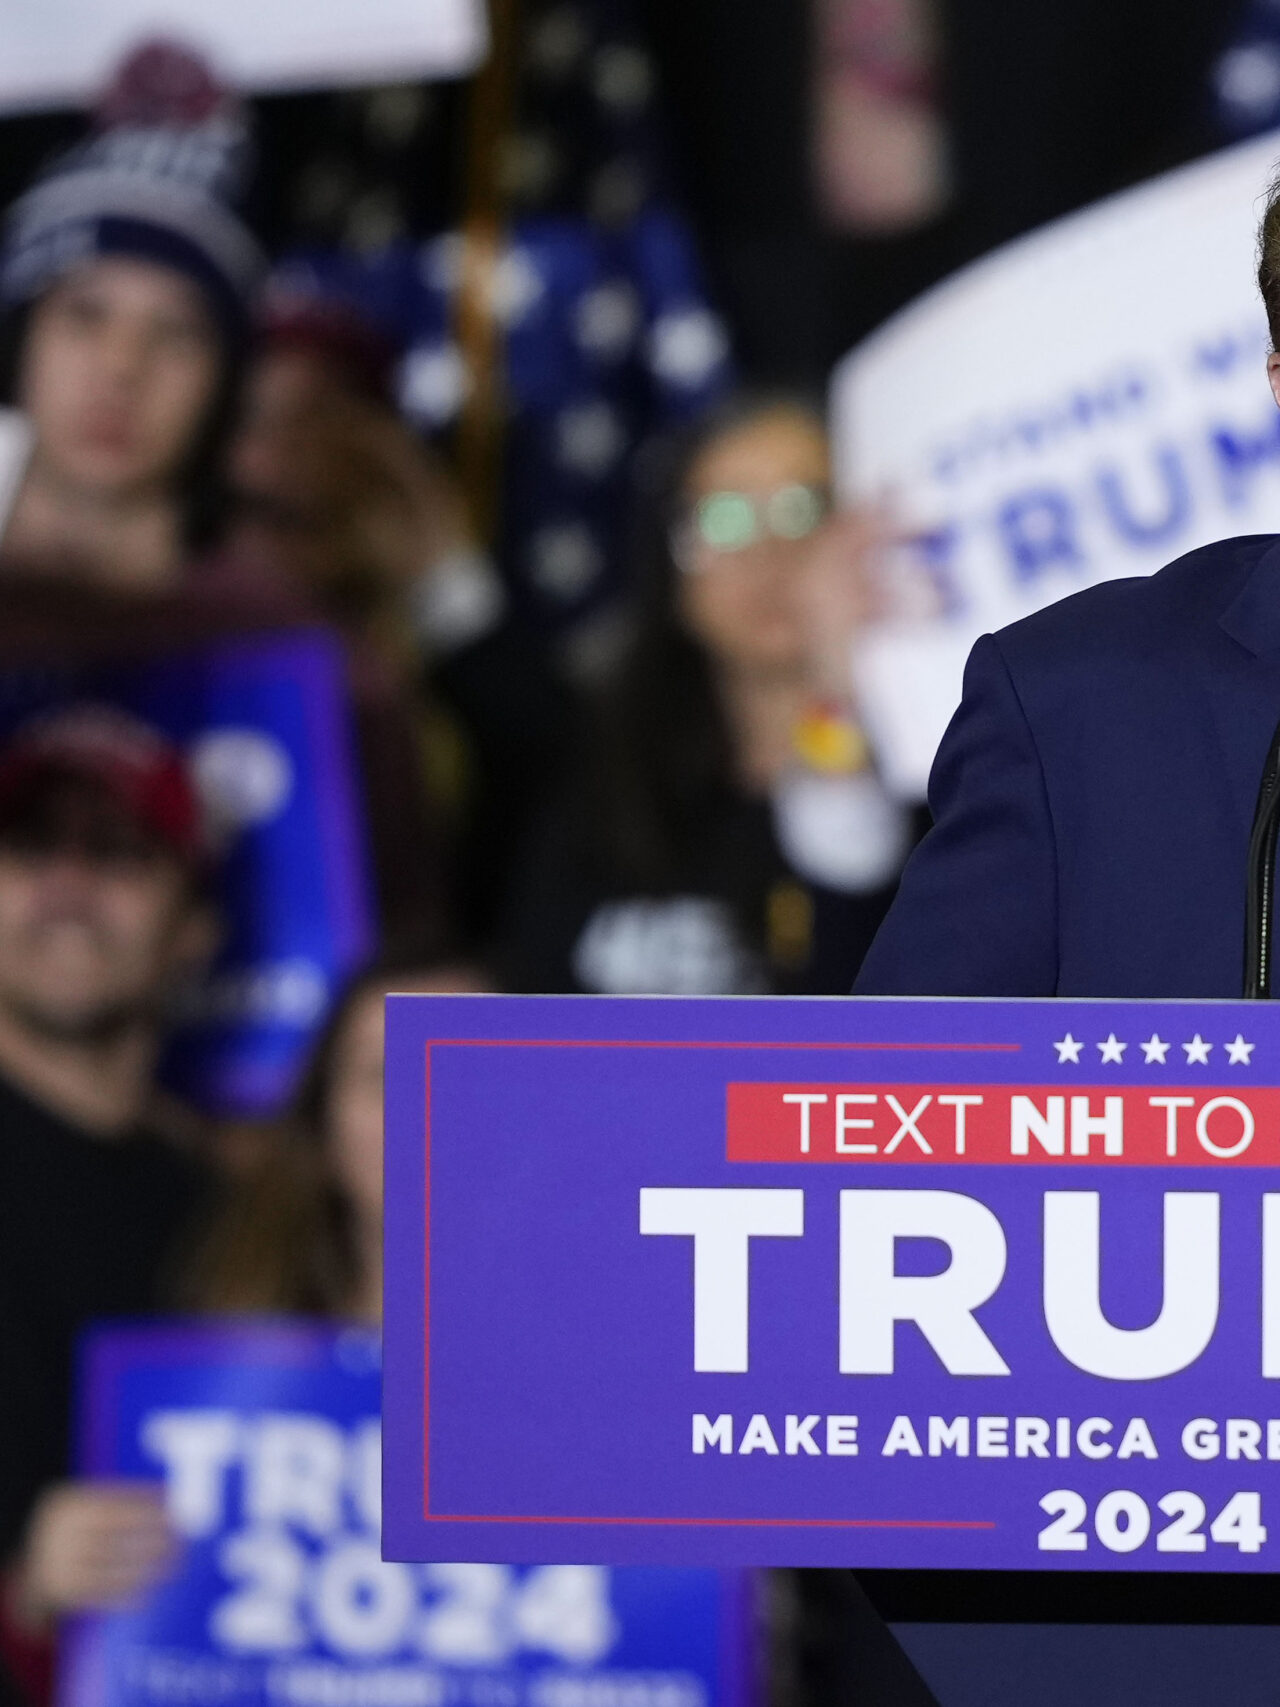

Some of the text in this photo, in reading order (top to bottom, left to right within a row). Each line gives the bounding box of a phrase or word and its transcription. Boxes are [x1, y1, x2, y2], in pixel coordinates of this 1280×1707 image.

[783, 1094, 984, 1156] TEXT
[1010, 1096, 1124, 1157] NH
[1148, 1097, 1255, 1158] TO
[692, 1413, 859, 1456] MAKE
[881, 1415, 1159, 1459] AMERICA
[1038, 1489, 1267, 1553] 2024
[212, 1525, 616, 1664] 2024
